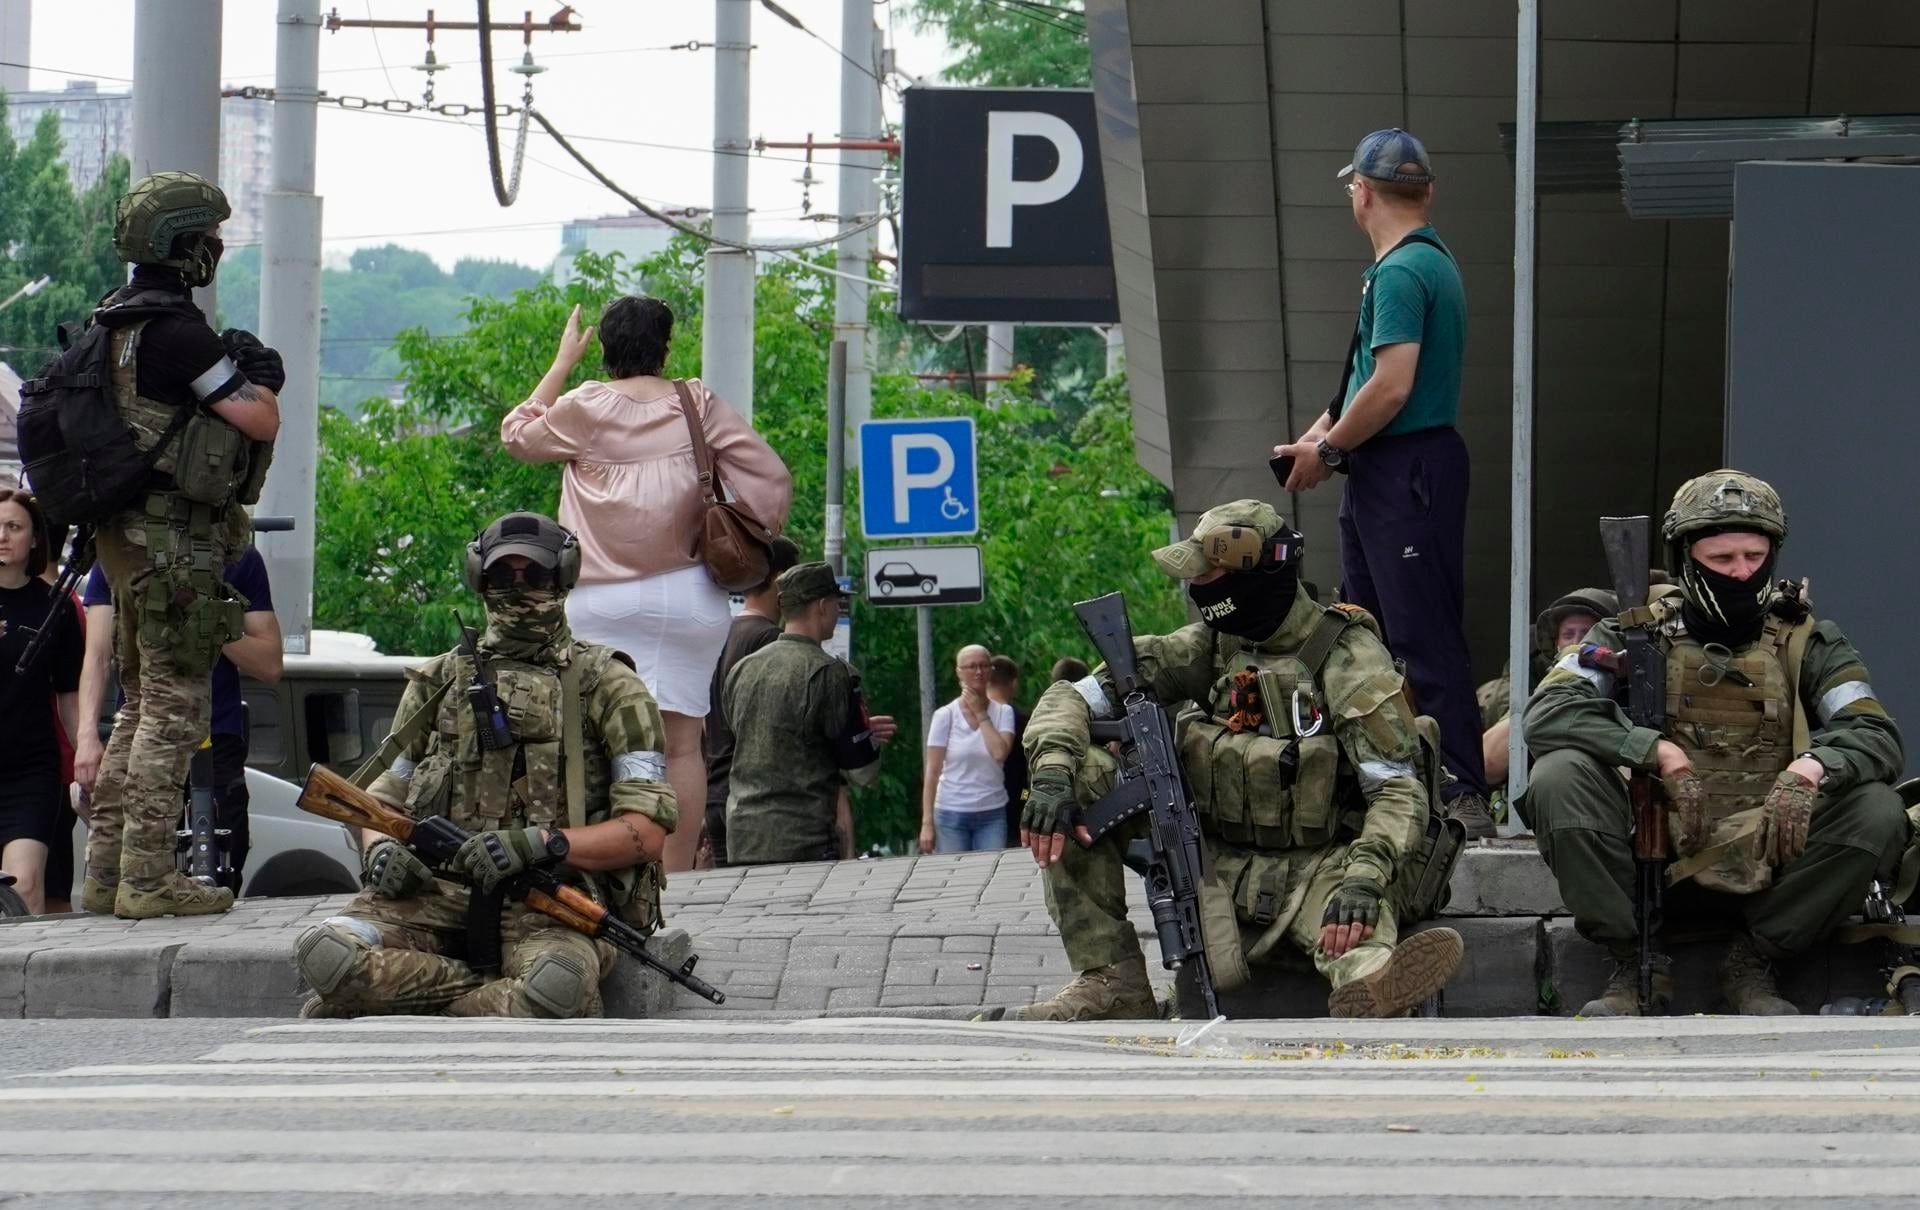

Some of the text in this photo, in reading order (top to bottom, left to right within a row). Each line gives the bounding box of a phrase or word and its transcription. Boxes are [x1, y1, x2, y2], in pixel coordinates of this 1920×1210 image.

[986, 111, 1084, 248] P
[892, 433, 955, 523] P
[1210, 597, 1232, 612] WOLF
[1215, 603, 1237, 618] PACK
